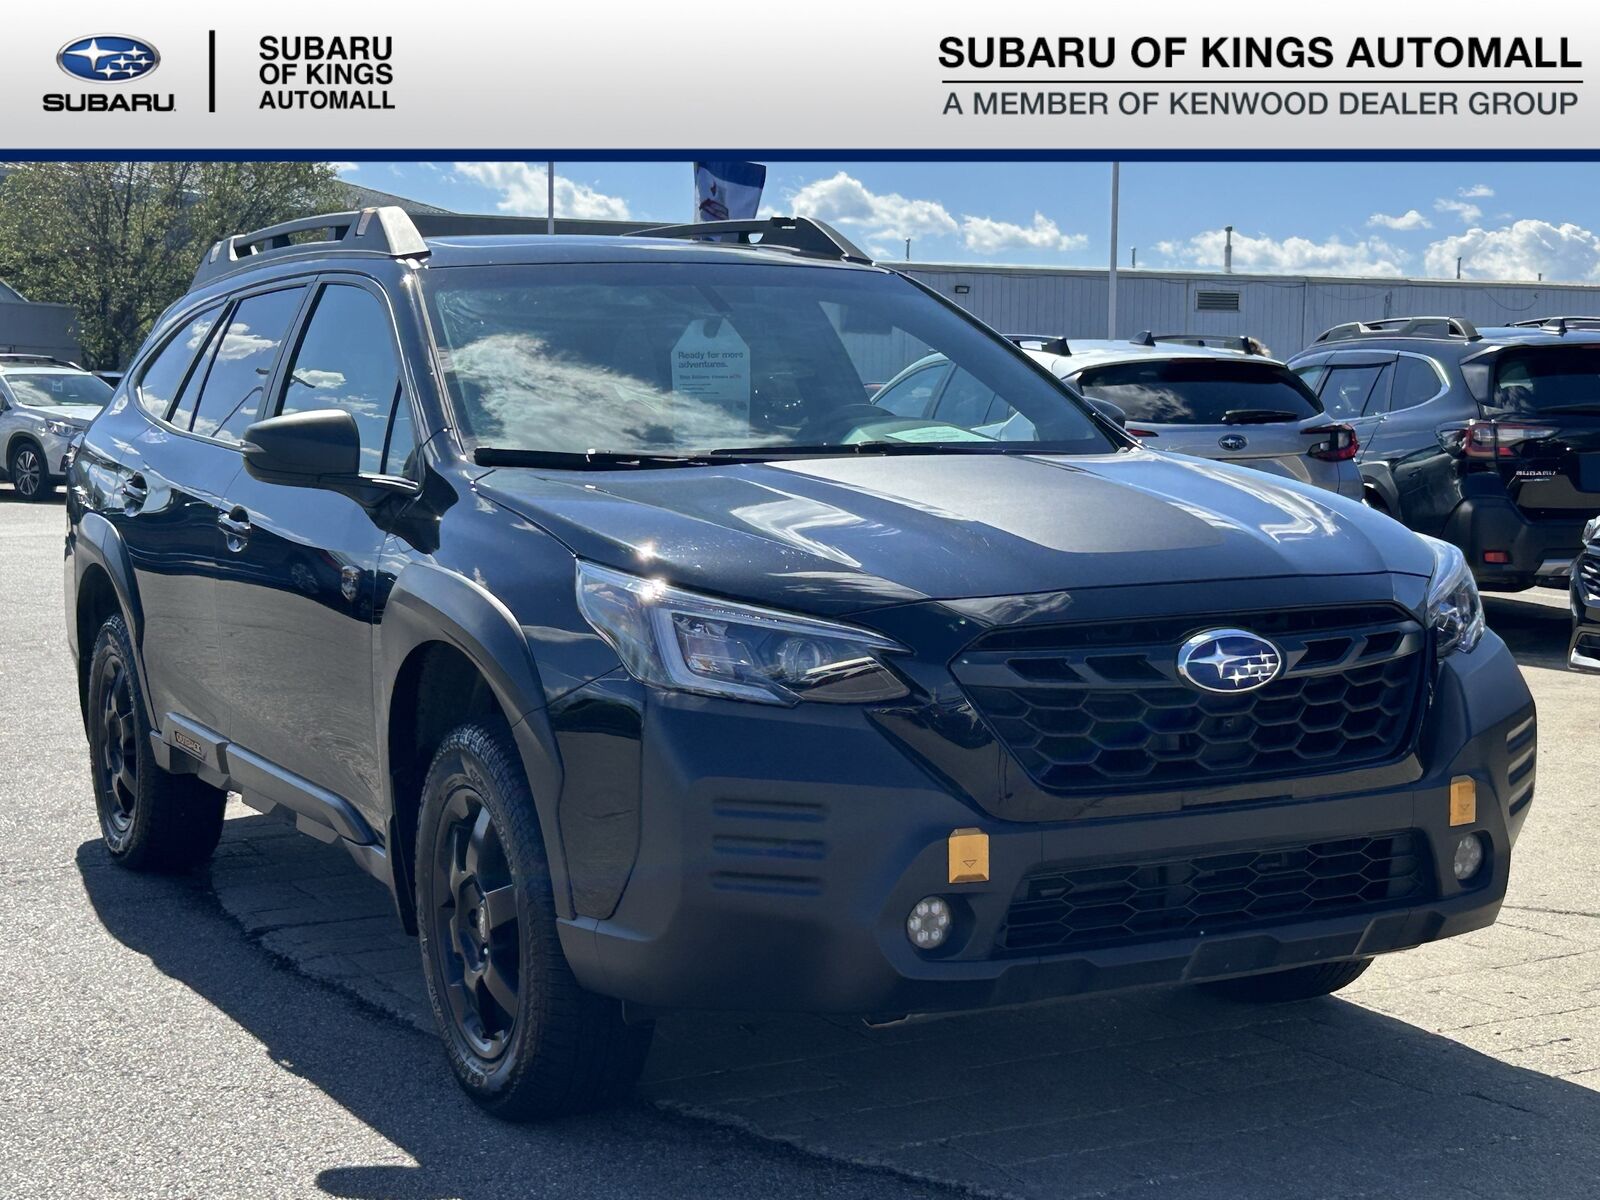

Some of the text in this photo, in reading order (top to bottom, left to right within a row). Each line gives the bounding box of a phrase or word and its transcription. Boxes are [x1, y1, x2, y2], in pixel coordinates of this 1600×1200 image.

[678, 351, 705, 360] Ready
[707, 351, 720, 359] for
[678, 361, 728, 369] adventures.
